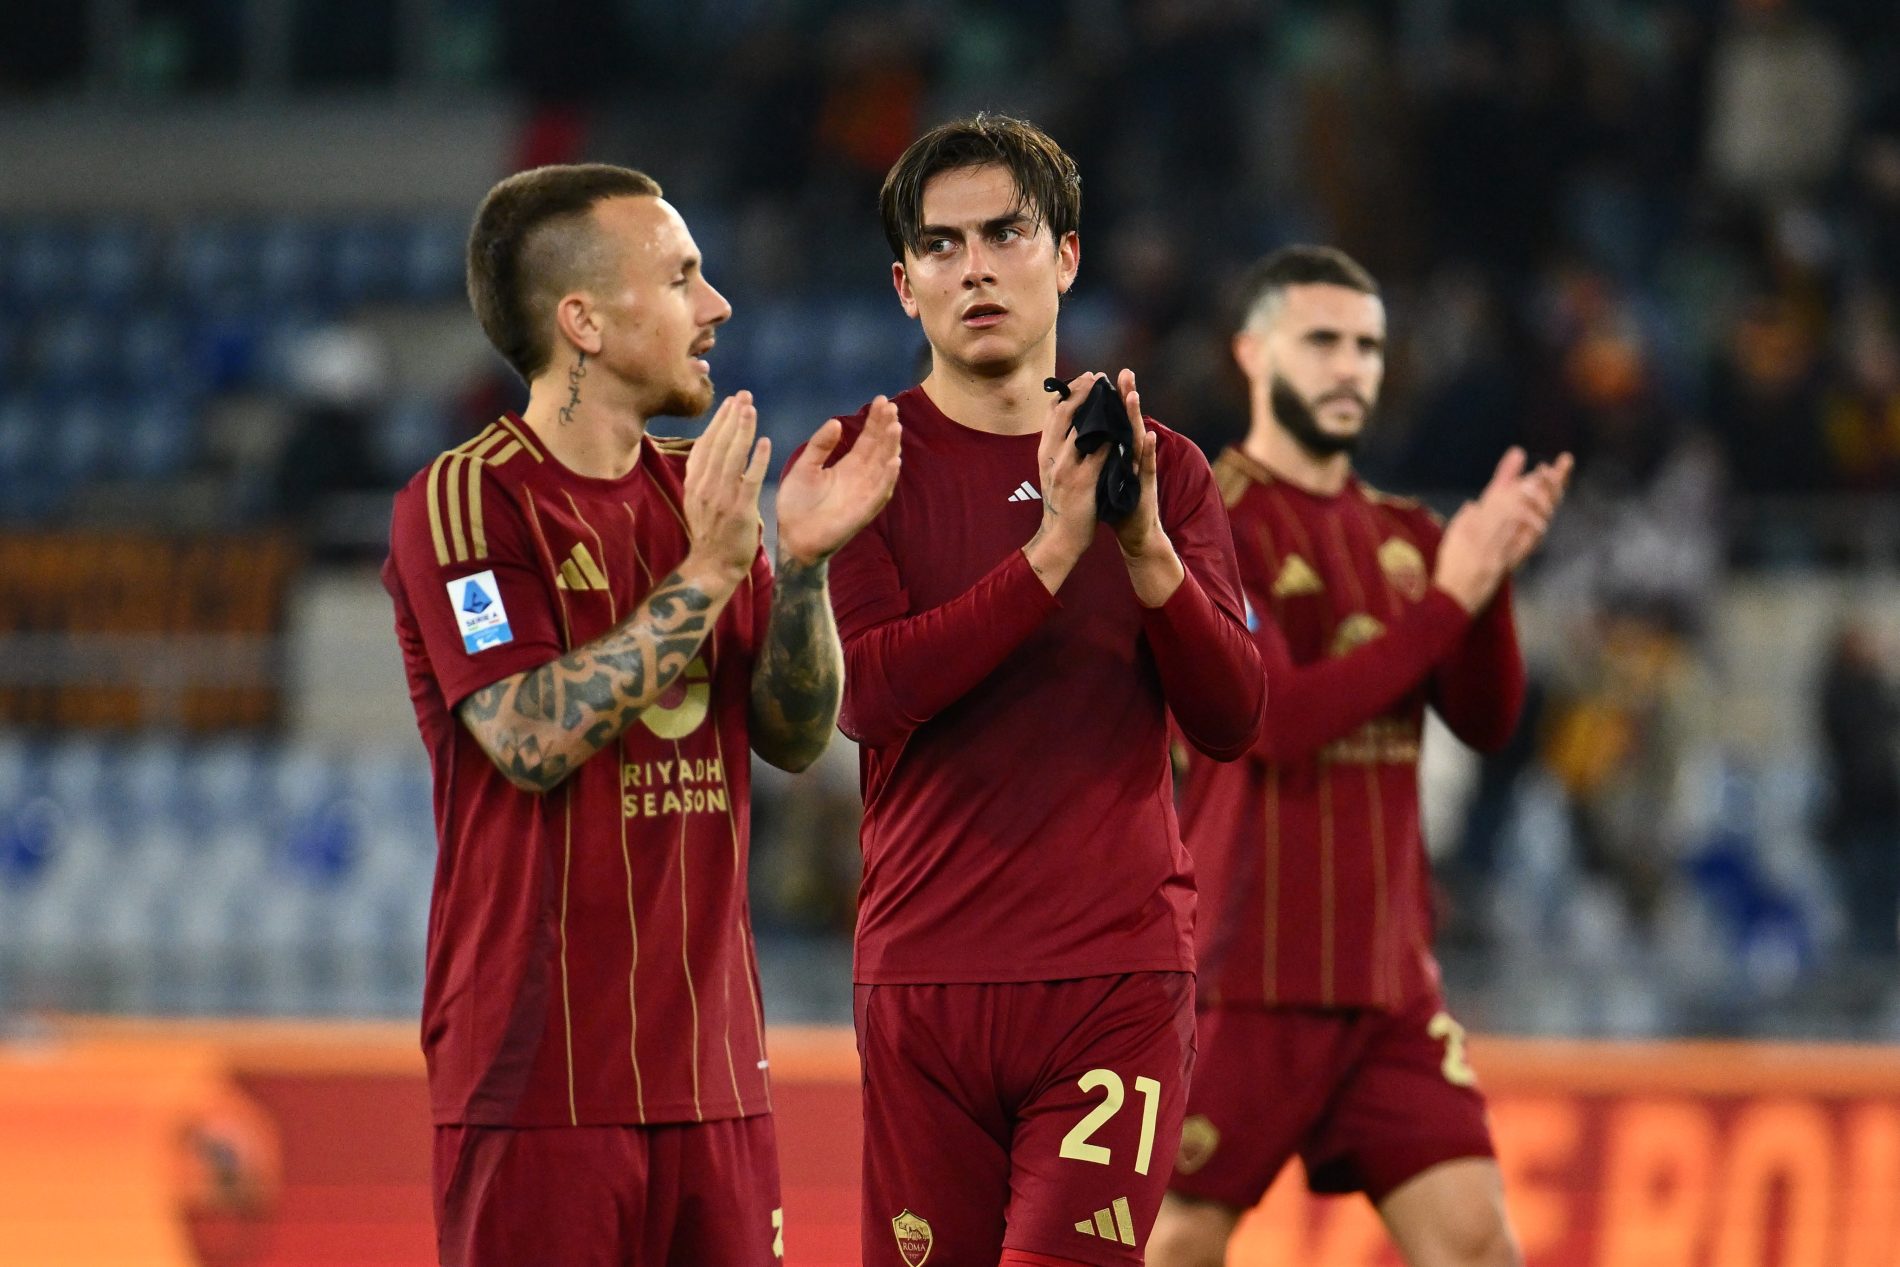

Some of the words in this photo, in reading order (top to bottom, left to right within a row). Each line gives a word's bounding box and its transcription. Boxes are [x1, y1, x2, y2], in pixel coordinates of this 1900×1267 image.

[624, 758, 722, 787] RIYADH
[623, 788, 727, 818] SEASON
[1059, 1068, 1161, 1176] 21
[902, 1241, 926, 1252] ROMA
